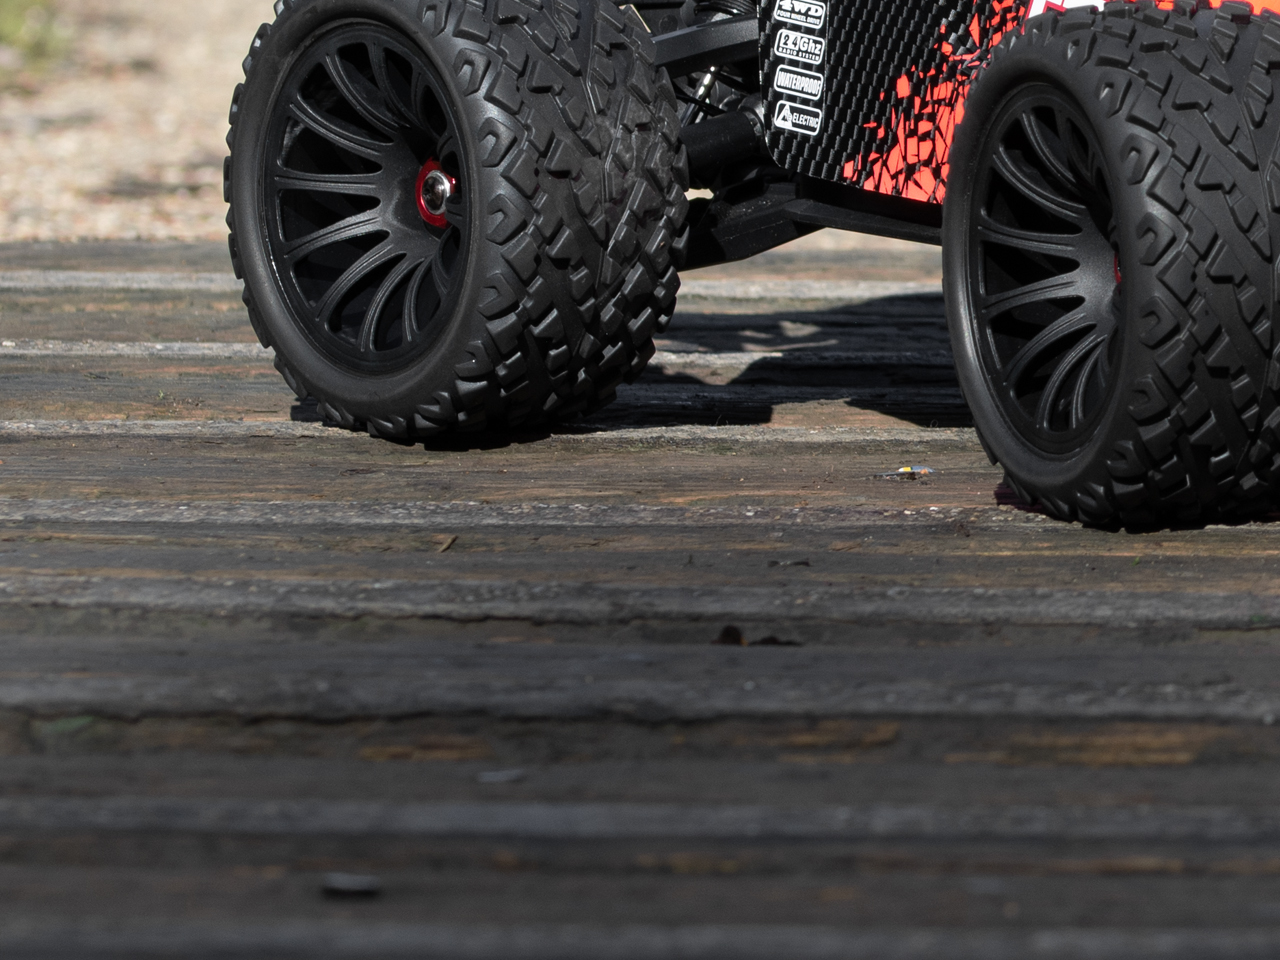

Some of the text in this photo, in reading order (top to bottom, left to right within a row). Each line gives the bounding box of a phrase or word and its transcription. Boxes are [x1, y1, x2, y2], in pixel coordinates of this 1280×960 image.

[778, 46, 820, 61] RADIO SYSTEM
[777, 70, 821, 95] WATERPROOF
[792, 112, 819, 128] ELECTRIC
